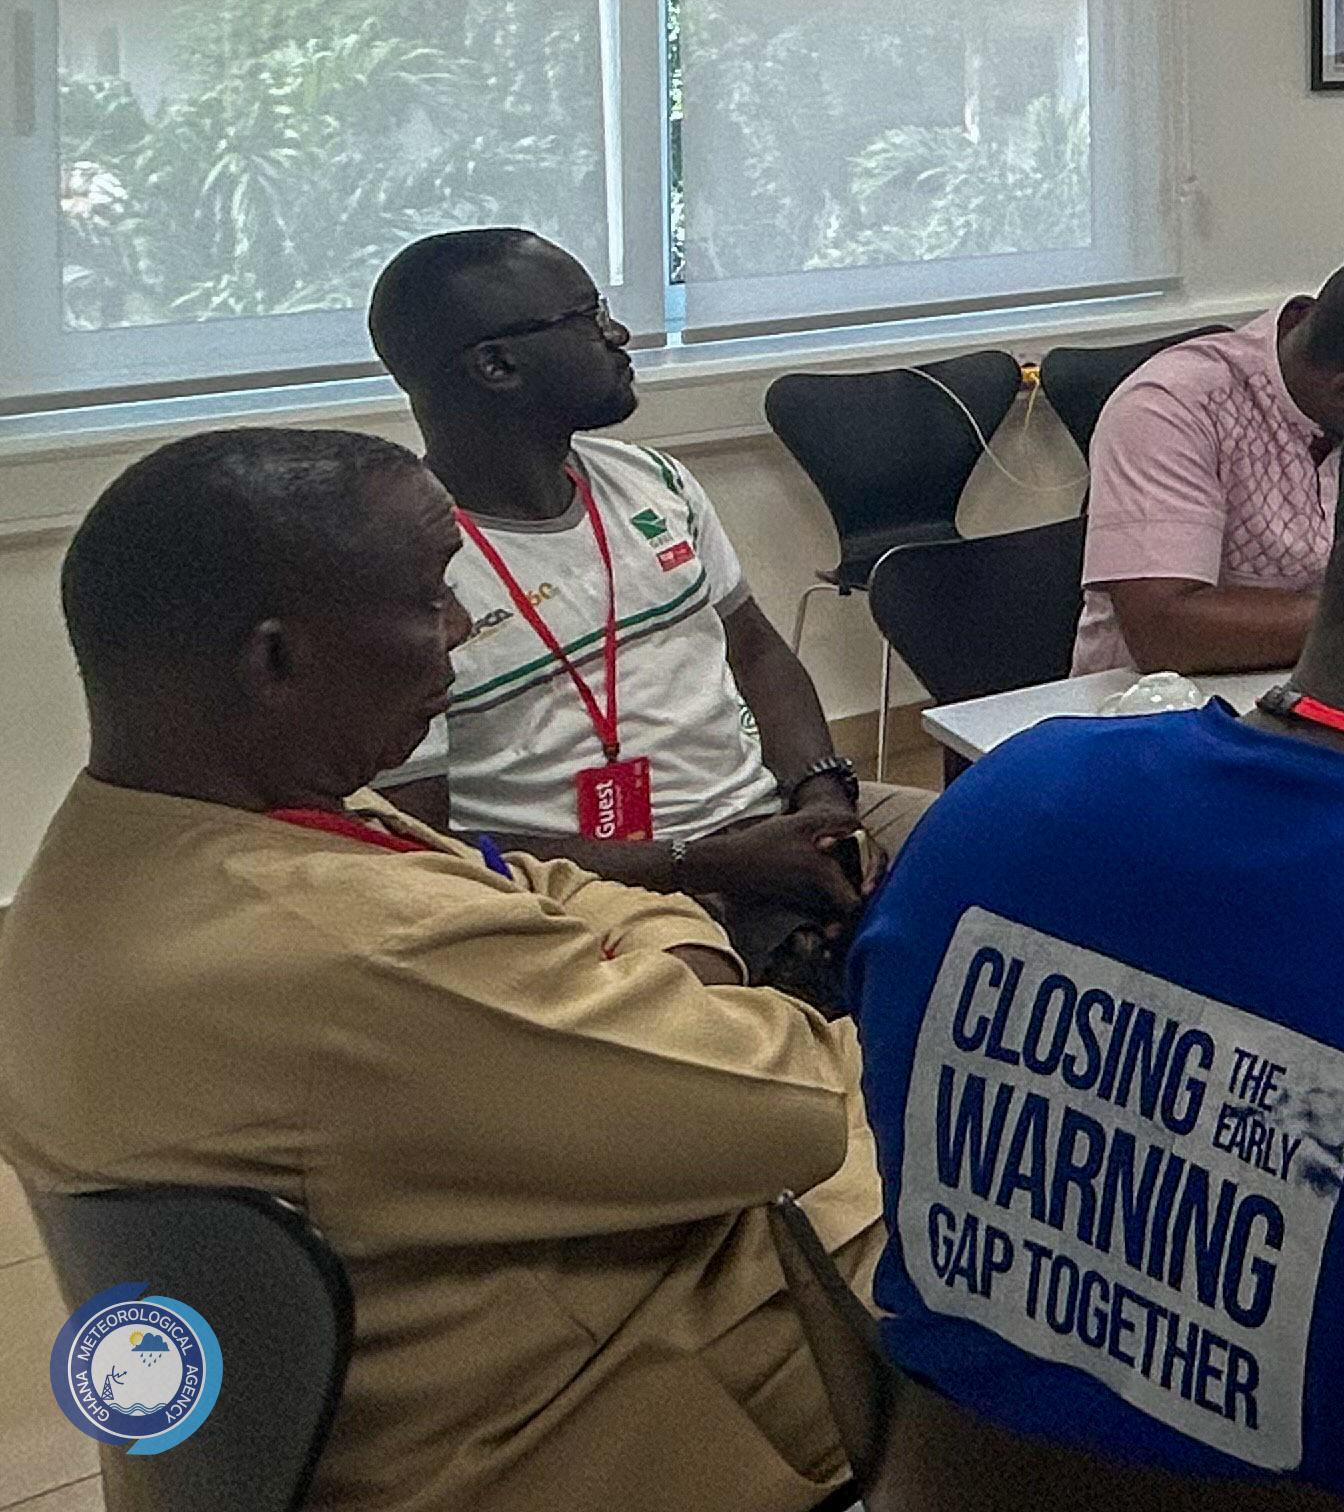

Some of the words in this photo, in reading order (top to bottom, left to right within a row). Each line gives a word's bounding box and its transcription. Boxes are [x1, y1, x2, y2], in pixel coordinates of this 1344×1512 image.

[595, 779, 615, 838] Guest
[952, 945, 1215, 1136] CLOSING
[1228, 1046, 1286, 1112] THE
[935, 1064, 1285, 1328] WARNING
[1212, 1104, 1300, 1181] EARLY
[927, 1202, 1014, 1300] GAP
[1022, 1238, 1260, 1431] TOGETHER
